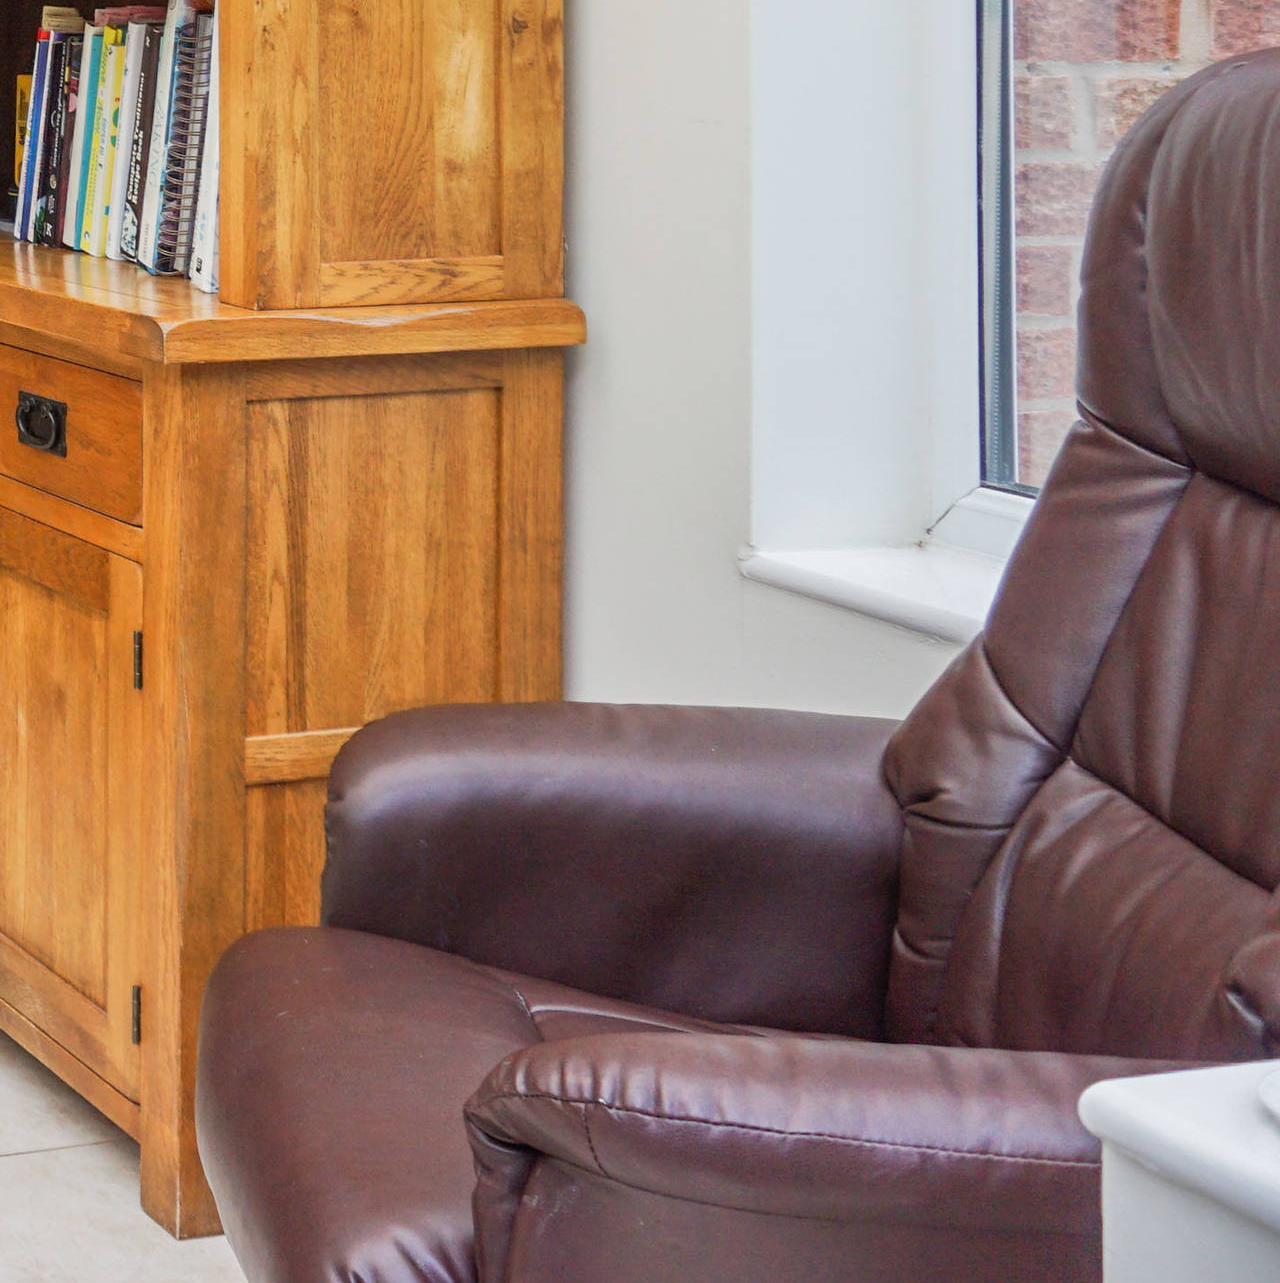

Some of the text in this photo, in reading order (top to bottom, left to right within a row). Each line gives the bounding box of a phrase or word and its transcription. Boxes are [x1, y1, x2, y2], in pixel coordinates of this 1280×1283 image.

[127, 72, 145, 200] Complete Traditional
[131, 129, 144, 205] Recipe Book
